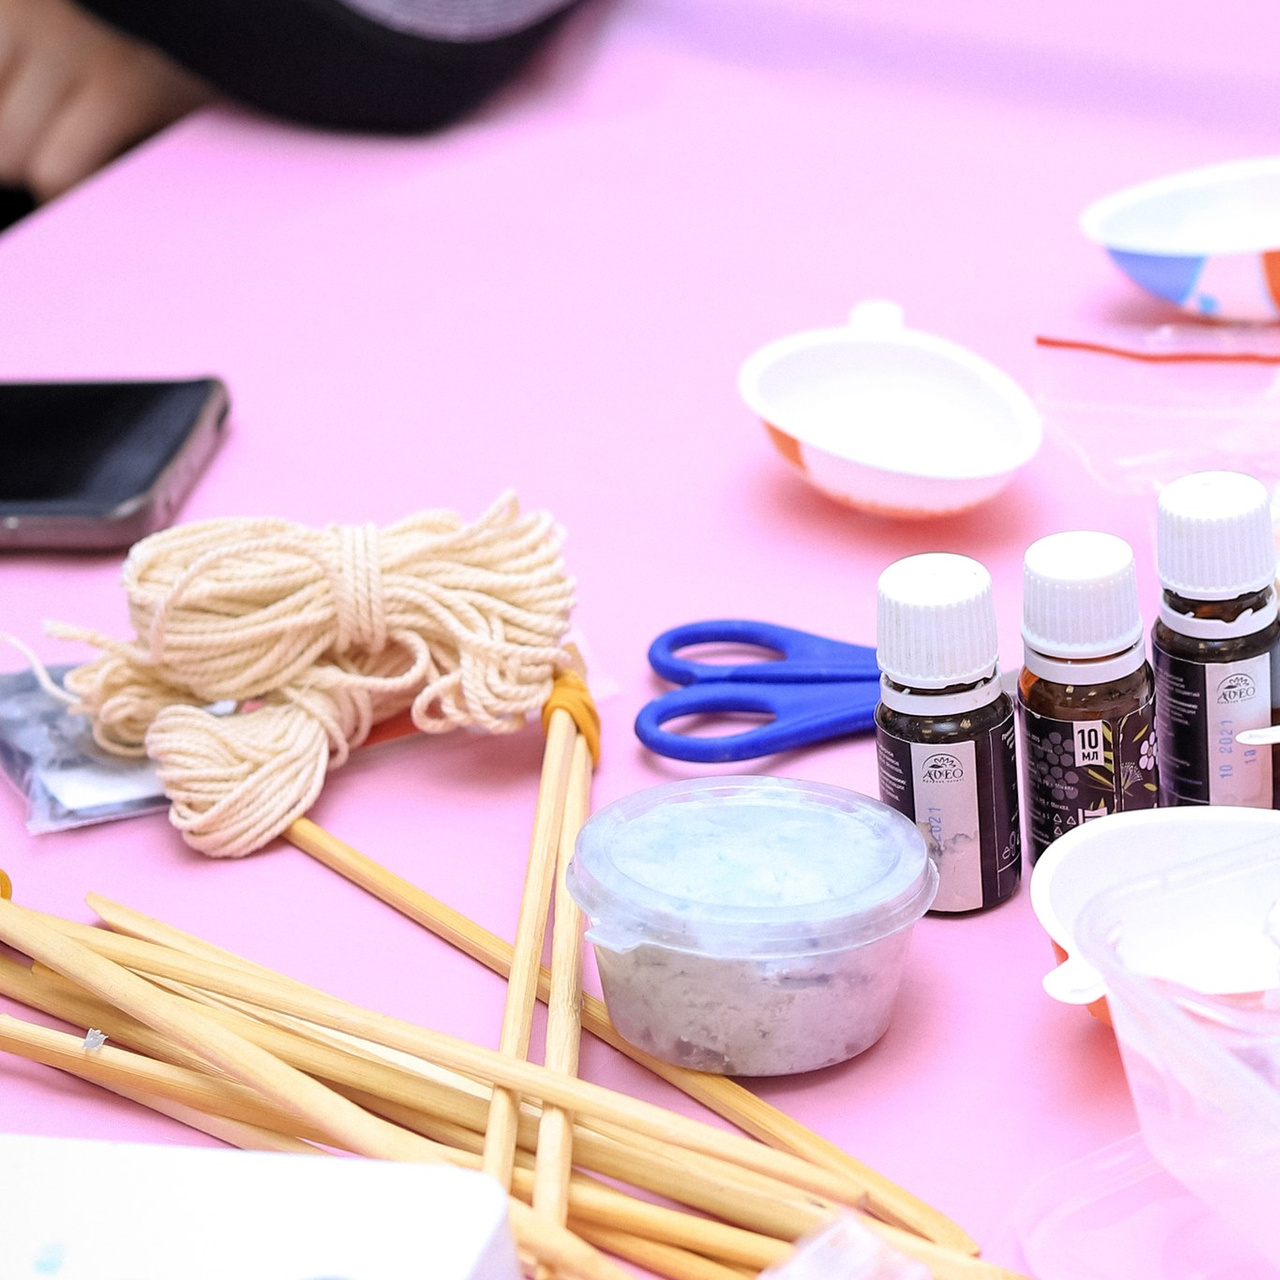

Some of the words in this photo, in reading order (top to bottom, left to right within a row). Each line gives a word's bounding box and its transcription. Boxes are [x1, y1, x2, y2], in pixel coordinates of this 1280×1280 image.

[1077, 728, 1099, 750] 10
[1219, 720, 1233, 754] 2021
[1219, 764, 1233, 779] 10
